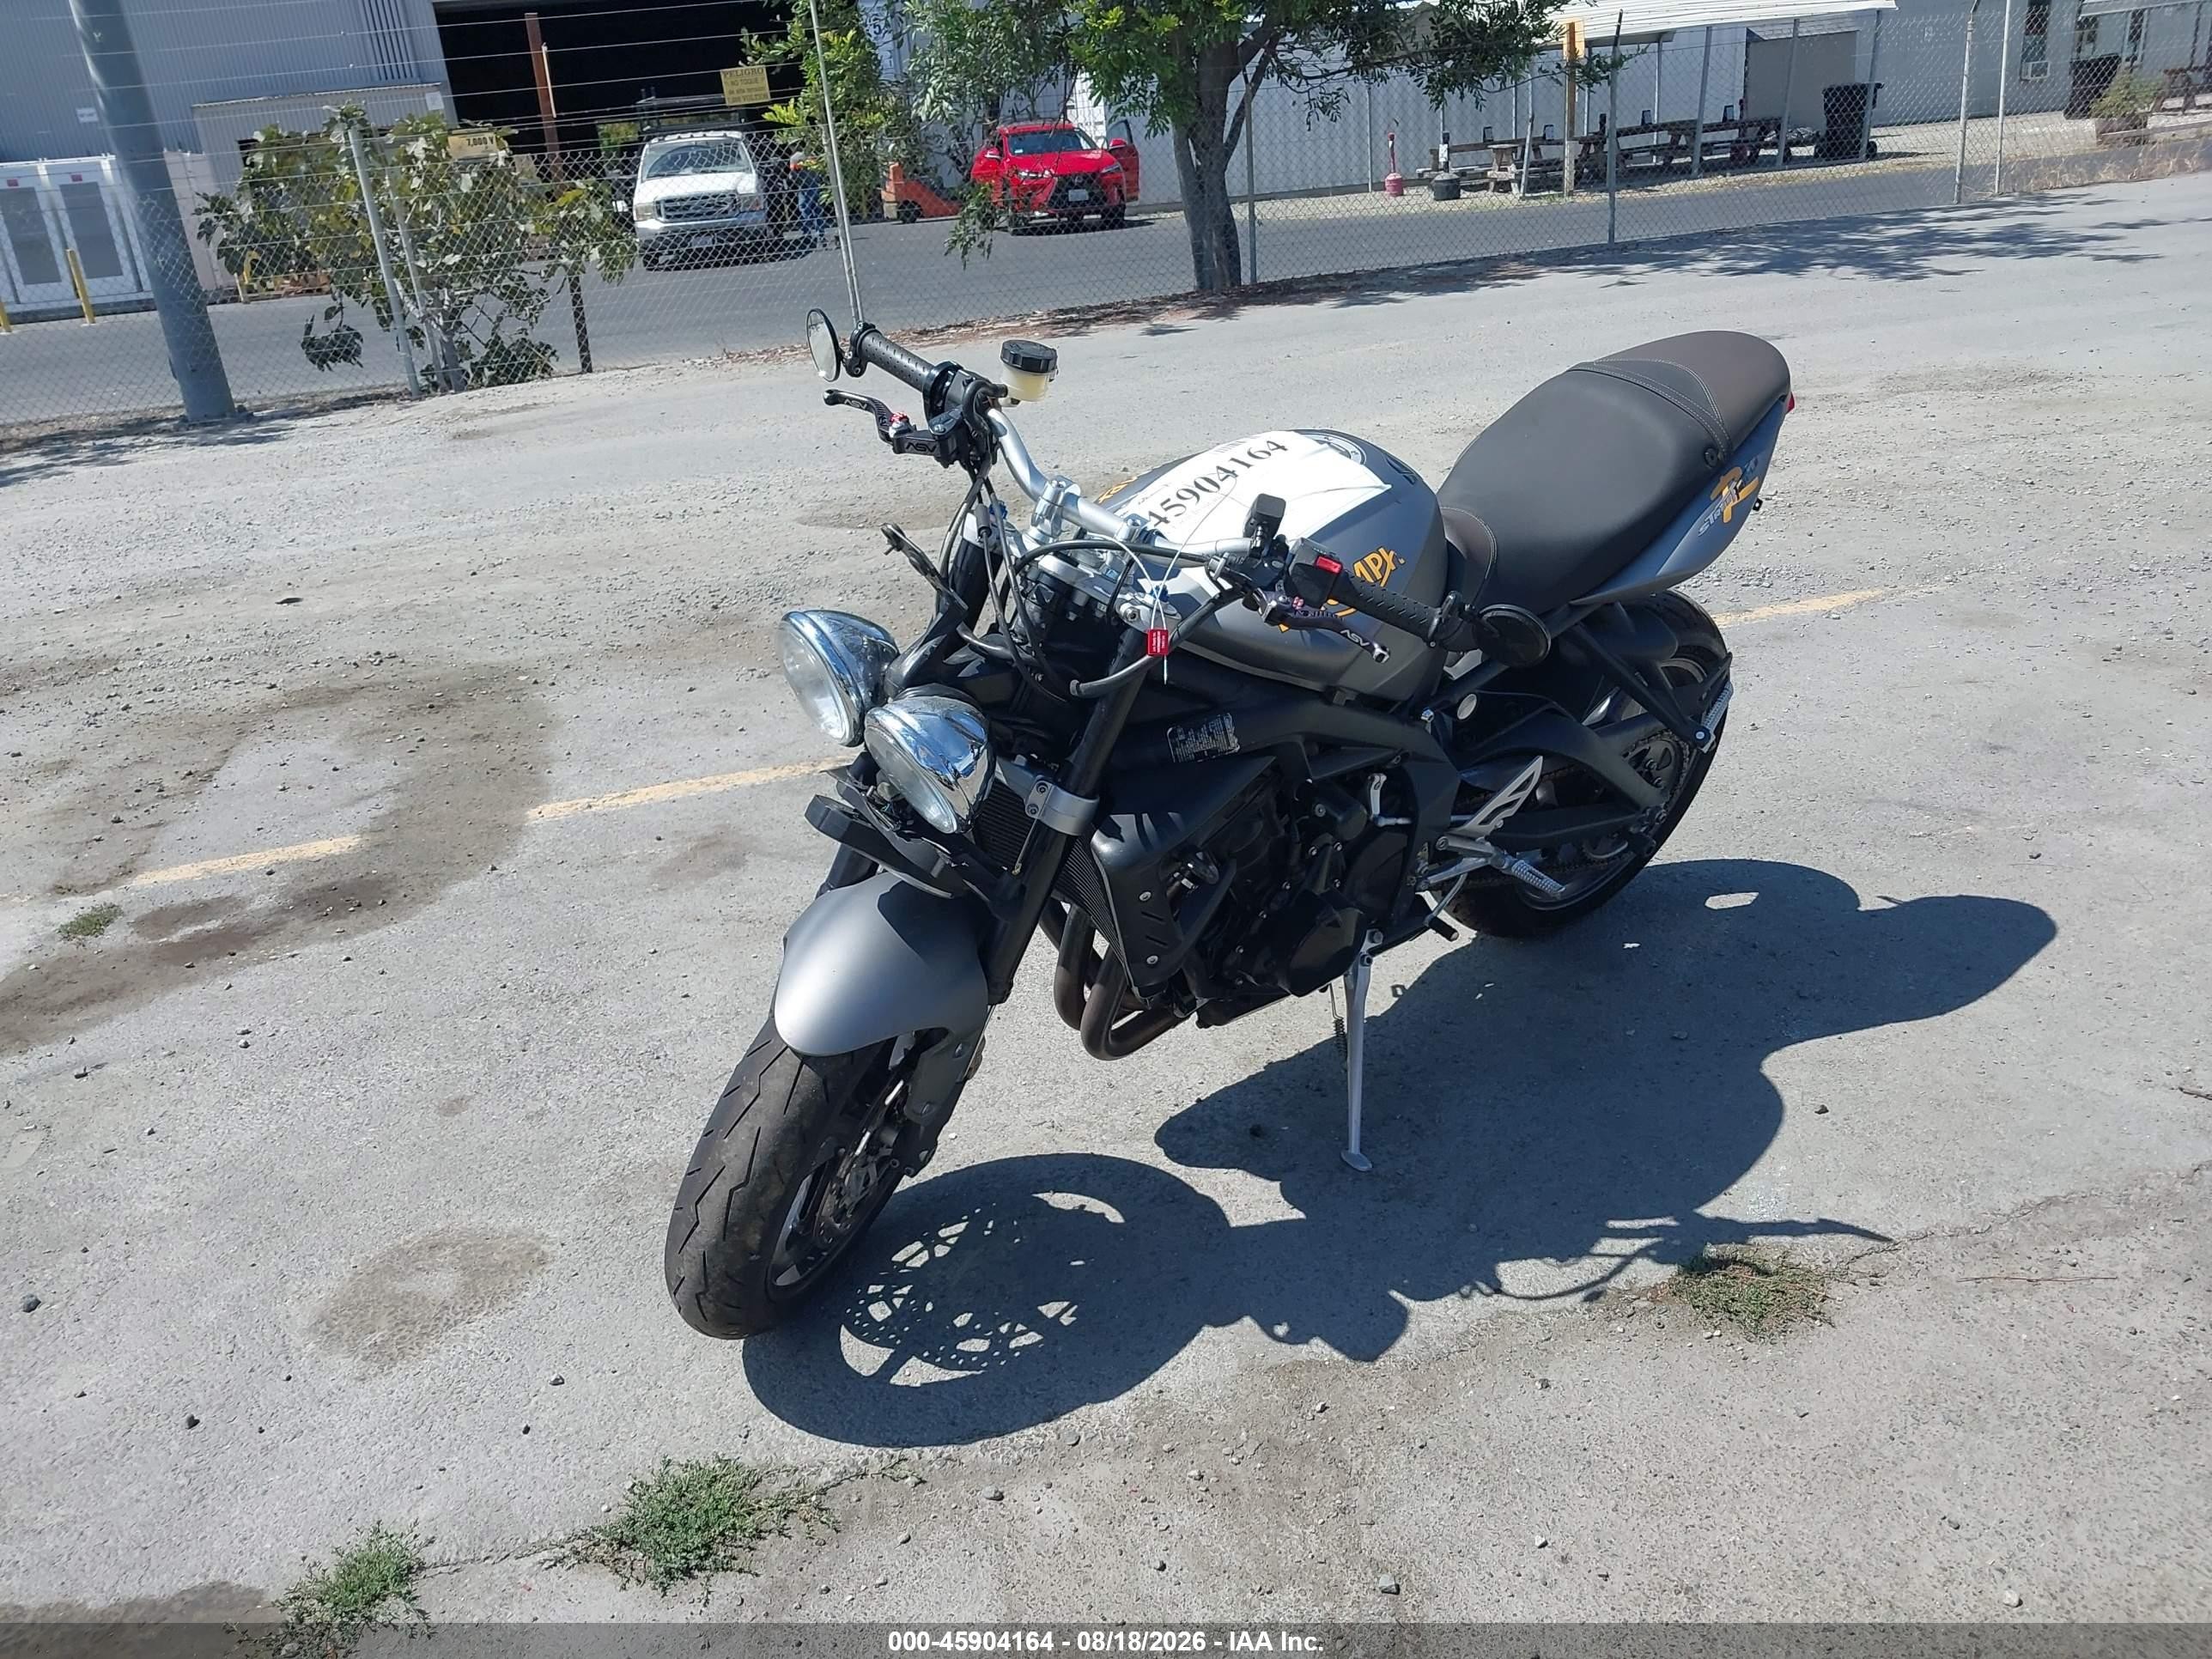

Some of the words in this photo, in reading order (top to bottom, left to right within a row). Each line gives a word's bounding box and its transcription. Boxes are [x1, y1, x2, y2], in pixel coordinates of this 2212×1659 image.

[724, 68, 763, 77] PELIGRO
[466, 137, 488, 147] 7,000
[489, 136, 495, 144] V
[905, 441, 938, 453] ASV
[1147, 439, 1289, 527] 45904164
[1340, 629, 1370, 647] ASV
